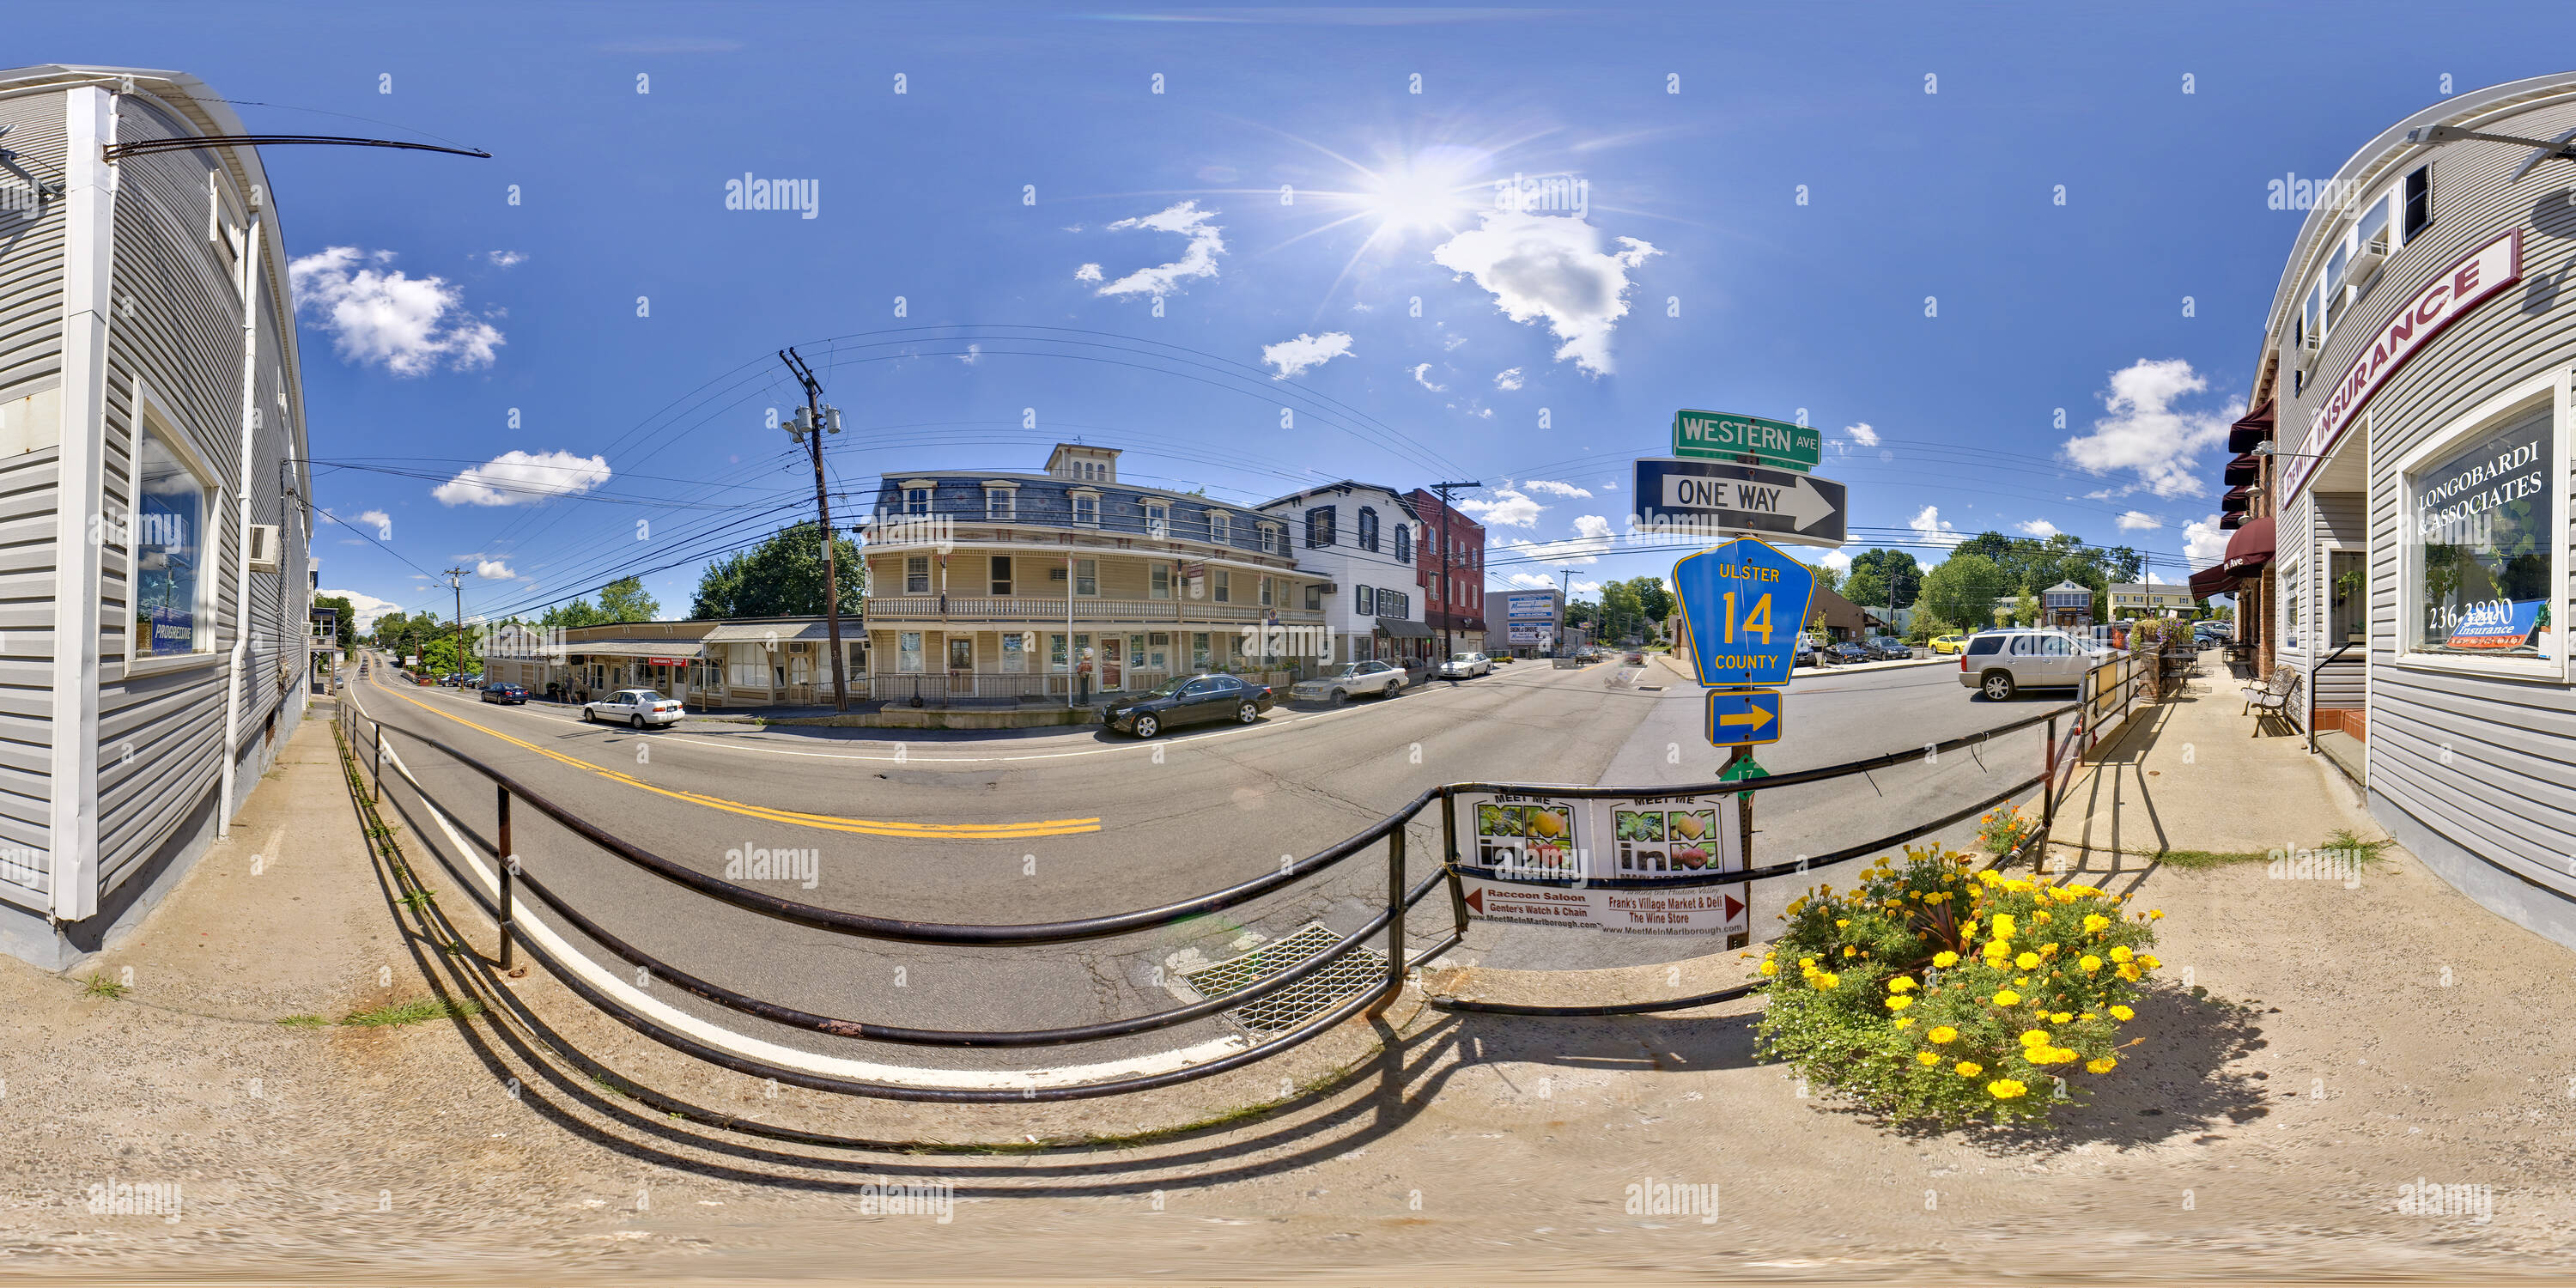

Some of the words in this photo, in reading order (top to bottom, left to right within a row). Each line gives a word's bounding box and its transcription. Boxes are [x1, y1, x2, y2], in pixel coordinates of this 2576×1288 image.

[2317, 259, 2481, 446] INSURANCE
[1684, 417, 1791, 452] WESTERN
[1796, 435, 1817, 451] AVE
[2419, 440, 2539, 512] LONGOBARDI
[1679, 479, 1728, 507] ONE
[1738, 485, 1781, 513] WAY
[2417, 519, 2428, 536] &
[2430, 471, 2543, 532] ASSOCIATES
[2230, 558, 2244, 568] Ave
[1720, 563, 1780, 584] ULSTER
[1723, 592, 1773, 645] 14
[155, 624, 191, 640] PROGRESSIVE
[2457, 624, 2515, 635] Insurance
[1716, 655, 1778, 670] COUNTY
[1738, 770, 1753, 781] 17
[1495, 795, 1527, 804] MEET
[1634, 797, 1668, 805] MEET
[1676, 796, 1696, 805] ME
[1487, 889, 1542, 900] Raccoon
[1544, 892, 1586, 902] Saloon
[1698, 885, 1720, 895] Valley
[1490, 902, 1524, 914] Genter's
[1526, 905, 1552, 916] Watch
[1553, 907, 1560, 916] &
[1562, 908, 1588, 917] Chain
[1608, 896, 1636, 908] Frank's
[1638, 896, 1666, 911] Village
[1668, 896, 1696, 909] Market
[1698, 896, 1704, 908] &
[1706, 896, 1722, 908] Deli
[1629, 912, 1643, 922] The
[1645, 912, 1666, 923] Wine
[1668, 911, 1689, 923] Store
[1602, 923, 1742, 936] www.MeetMeInMarlborough.com
